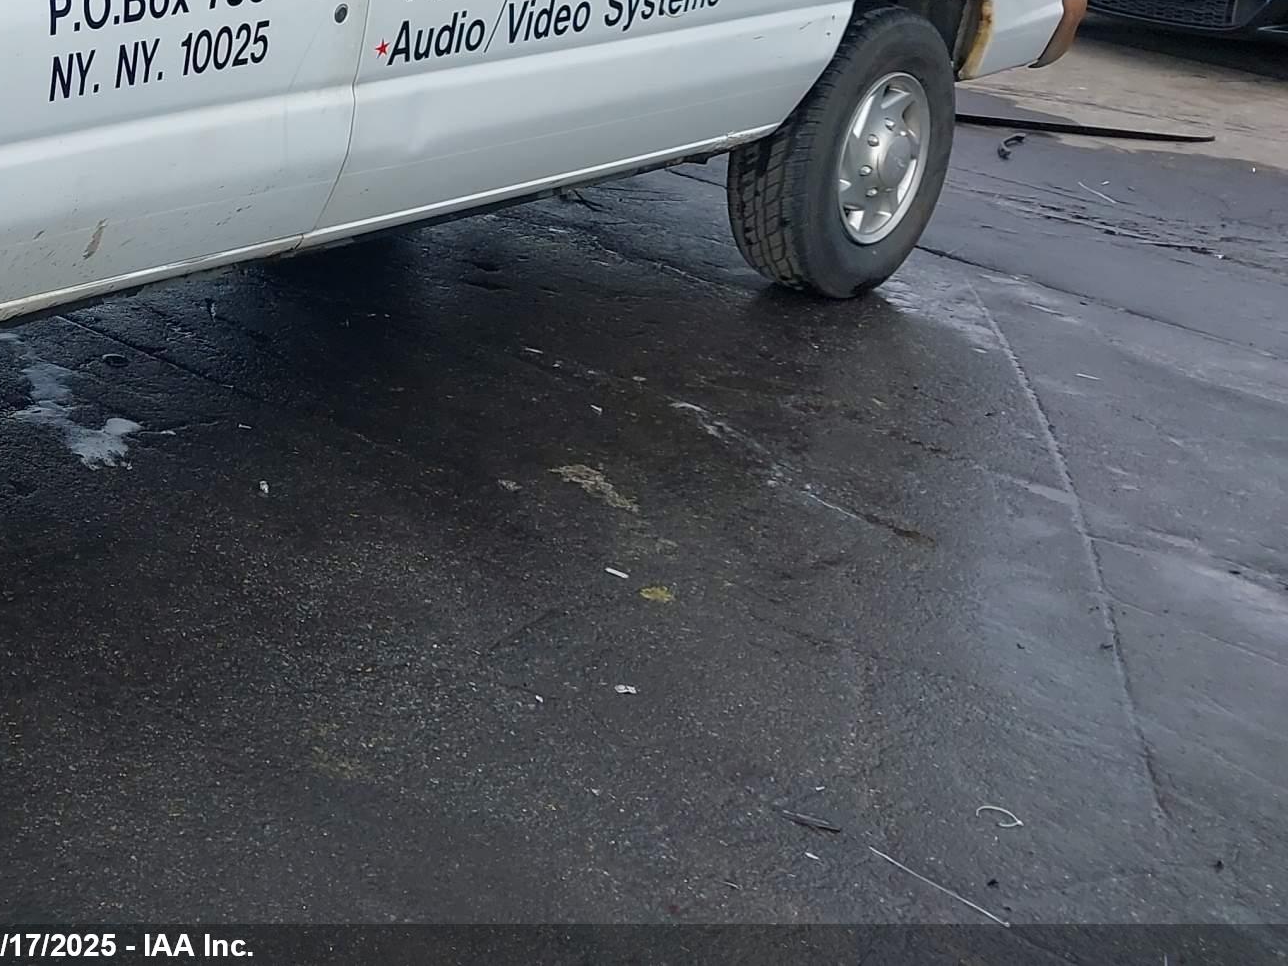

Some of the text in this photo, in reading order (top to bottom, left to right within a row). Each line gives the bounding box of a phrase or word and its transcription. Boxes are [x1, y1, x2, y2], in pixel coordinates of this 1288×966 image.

[48, 20, 270, 102] NY. NY. 10025
